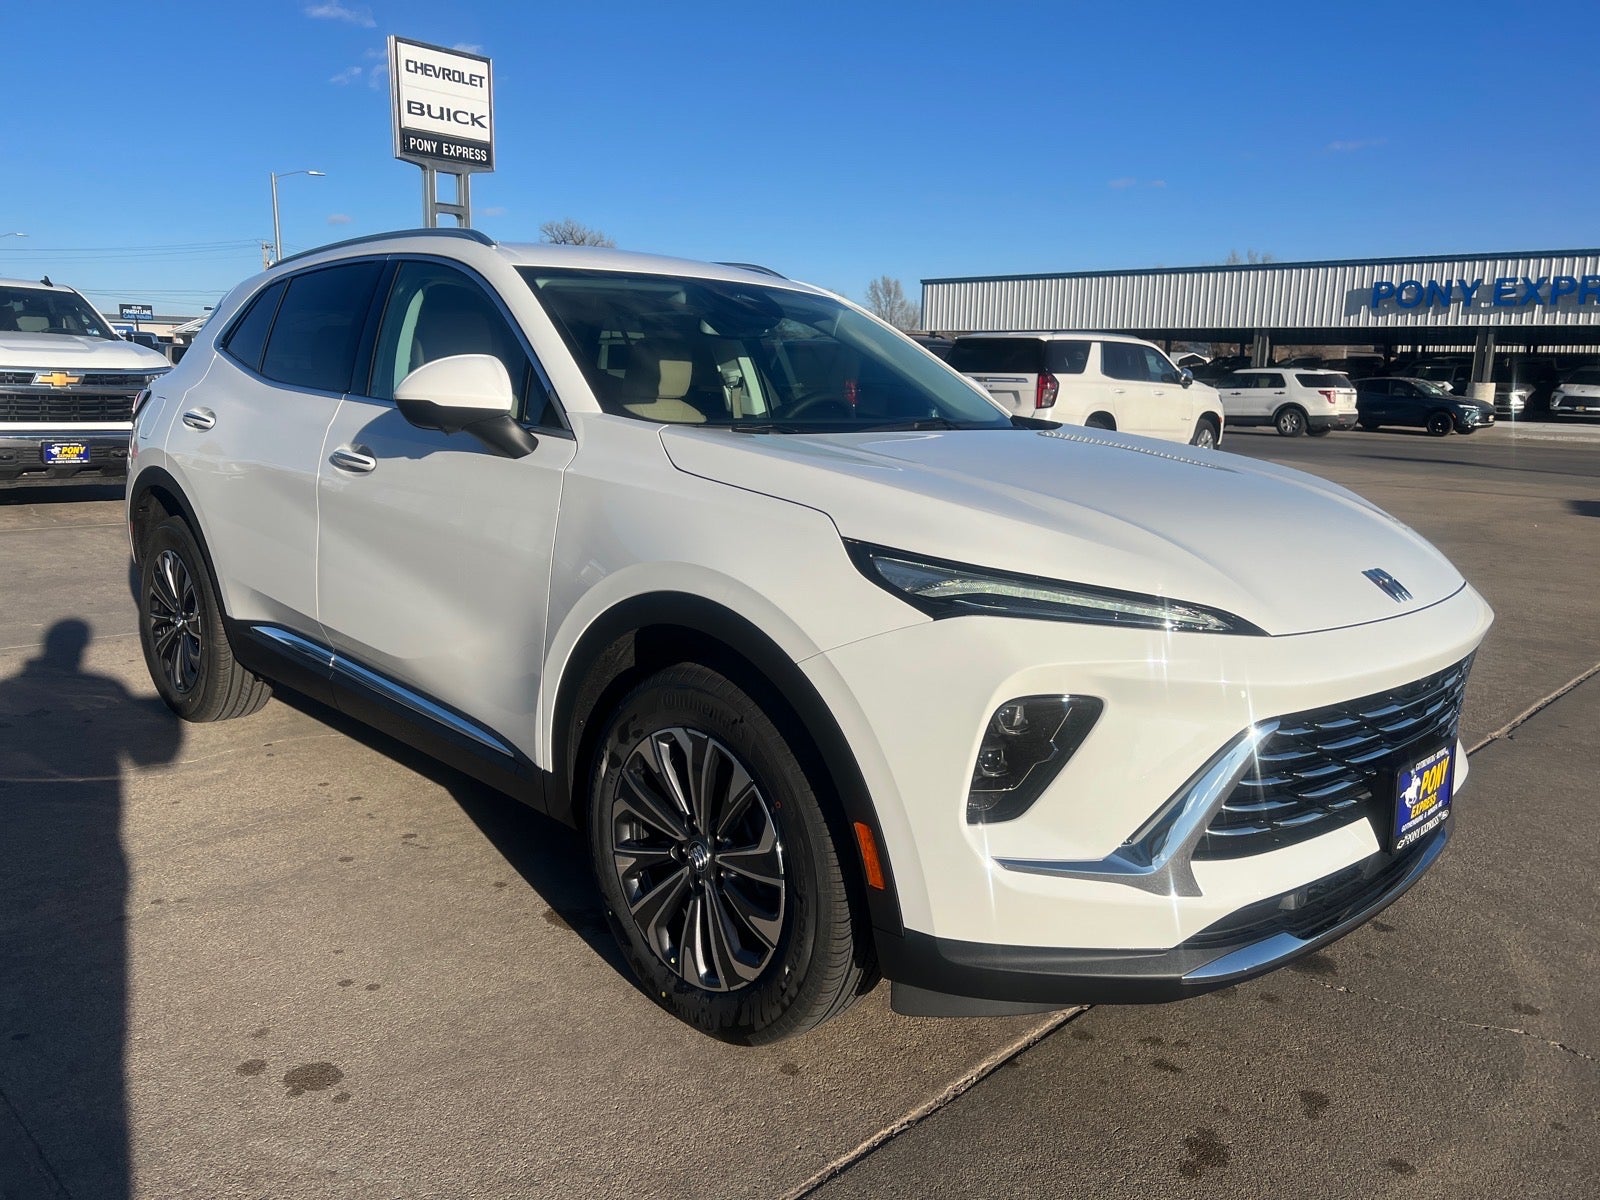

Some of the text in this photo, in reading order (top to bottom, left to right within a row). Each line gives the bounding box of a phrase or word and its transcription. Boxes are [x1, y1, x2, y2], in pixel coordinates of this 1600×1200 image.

[405, 59, 485, 88] CHEVROLET
[406, 99, 488, 129] BUICK
[409, 137, 487, 161] PONY EXPRESS
[1371, 275, 1600, 308] PONY EXPR
[61, 446, 86, 454] PONY
[1419, 756, 1450, 799] PONY
[1410, 792, 1437, 819] EXPRESS
